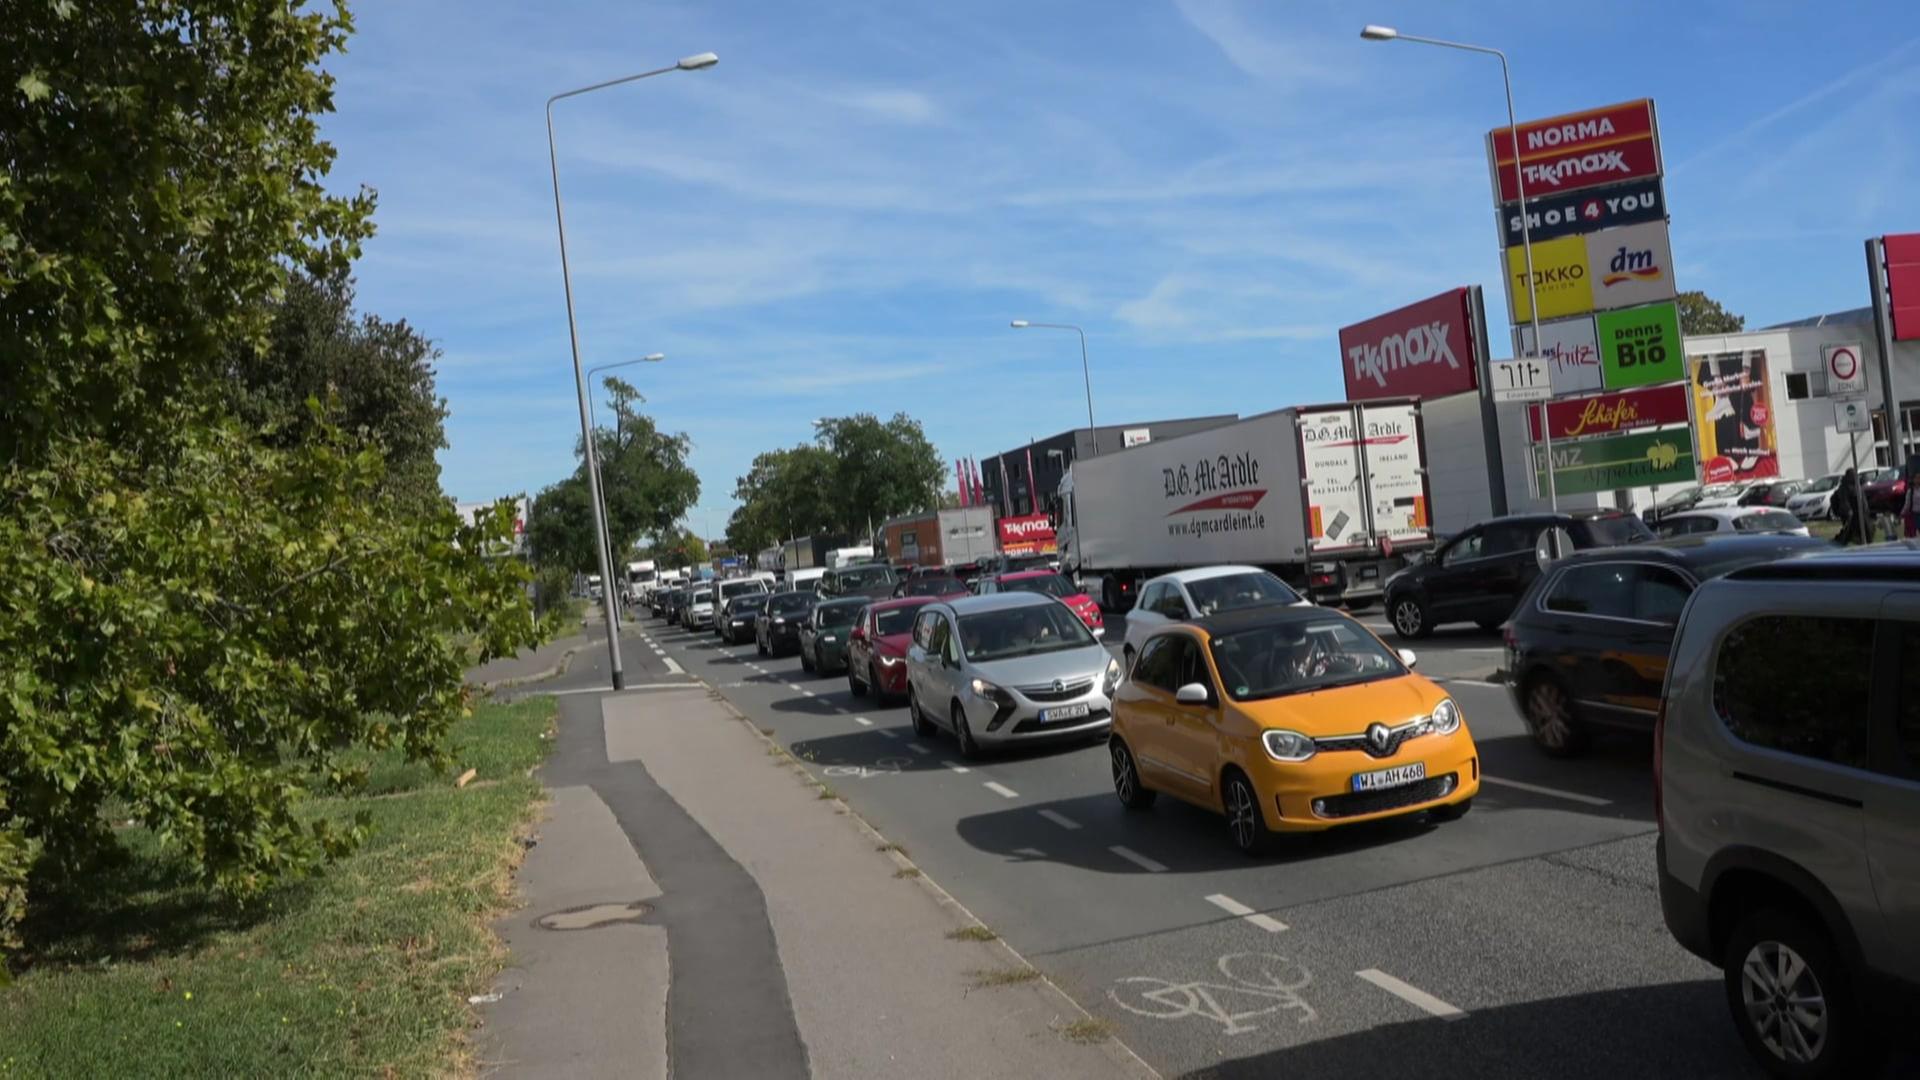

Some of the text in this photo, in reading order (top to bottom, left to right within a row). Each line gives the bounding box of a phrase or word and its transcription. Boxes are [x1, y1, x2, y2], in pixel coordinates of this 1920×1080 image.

[1528, 117, 1615, 149] NORMA
[1510, 192, 1655, 232] SHOE 4 YOU
[1611, 247, 1652, 274] dm
[1368, 421, 1402, 436] Ardle
[1565, 398, 1638, 435] Schäfer
[1379, 454, 1408, 462] IRELAND
[1168, 511, 1265, 538] www.dgmcardleint.ie
[1361, 773, 1376, 786] WI
